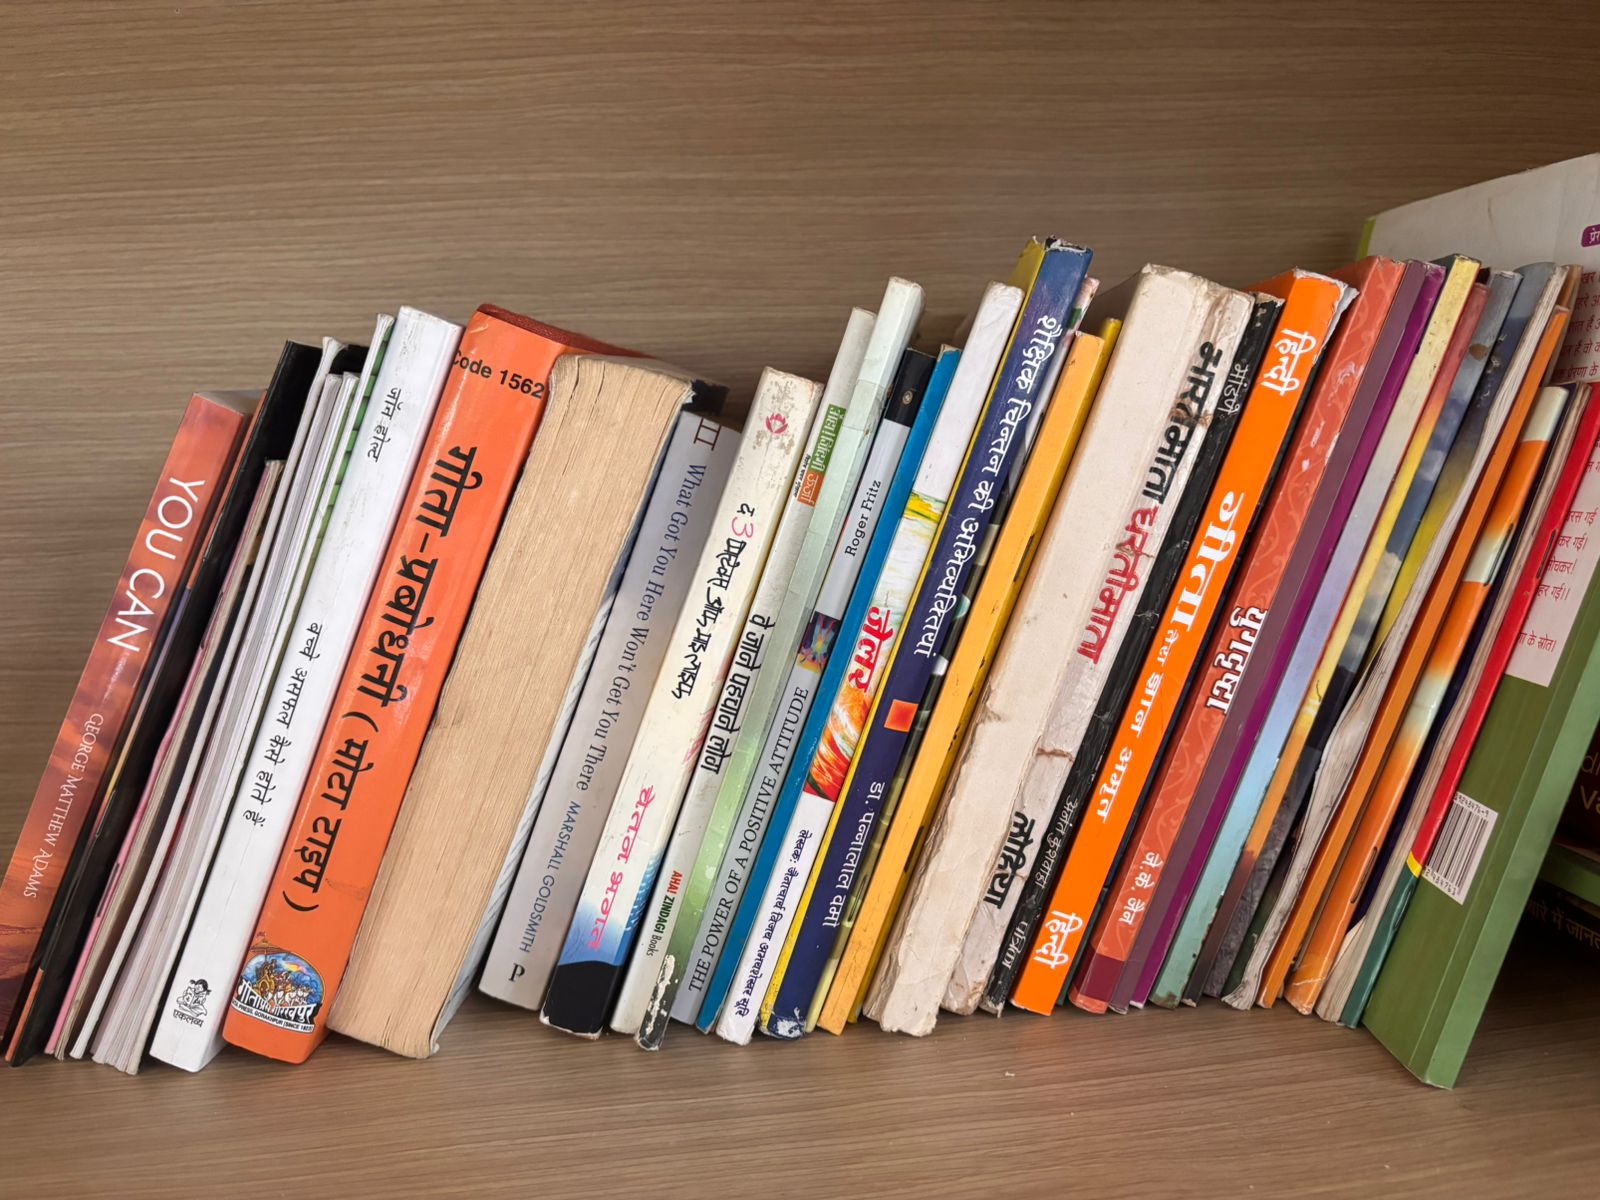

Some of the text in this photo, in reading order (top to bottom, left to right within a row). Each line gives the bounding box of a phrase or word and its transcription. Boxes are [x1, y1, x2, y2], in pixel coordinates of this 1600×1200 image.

[499, 369, 546, 400] 1562
[1015, 315, 1063, 395] शैक्षिक
[1261, 328, 1317, 396] हिन्दी
[367, 387, 403, 463] जॉन होल्ट
[981, 397, 1032, 477] चिन्तन
[145, 477, 206, 560] YOU
[731, 516, 754, 539] 3
[736, 502, 756, 517] द
[844, 480, 882, 557] Roger Fritz
[967, 480, 995, 513] की
[107, 568, 165, 652] CAN
[576, 464, 708, 791] What Got You Here Won't Get You There
[846, 605, 894, 692] जेलर
[700, 608, 777, 775] वे जाने पहचाने लोग
[1096, 491, 1245, 823] गीता तेरा ज्ञान अमृत
[242, 622, 323, 828] बच्चे असफल कैसे होते हैं
[23, 713, 104, 898] GEORGE MATTHEW ADAMS
[689, 686, 809, 994] THE POWER OF A POSITIVE ATTITUDE
[519, 800, 582, 954] MARSHALL GOLDSMITH
[588, 784, 656, 950] चेतन भगत
[773, 866, 799, 912] जैनाचार्य
[835, 812, 875, 890] पन्नालाल
[982, 811, 1036, 910] लोहिया
[645, 870, 683, 957] AHA! ZINDAGI Books
[762, 911, 784, 941] विजय
[1033, 910, 1084, 970] हिन्दी
[1118, 897, 1146, 926] जैन
[173, 1008, 204, 1028] एकलव्य
[734, 997, 750, 1018] सूरि
